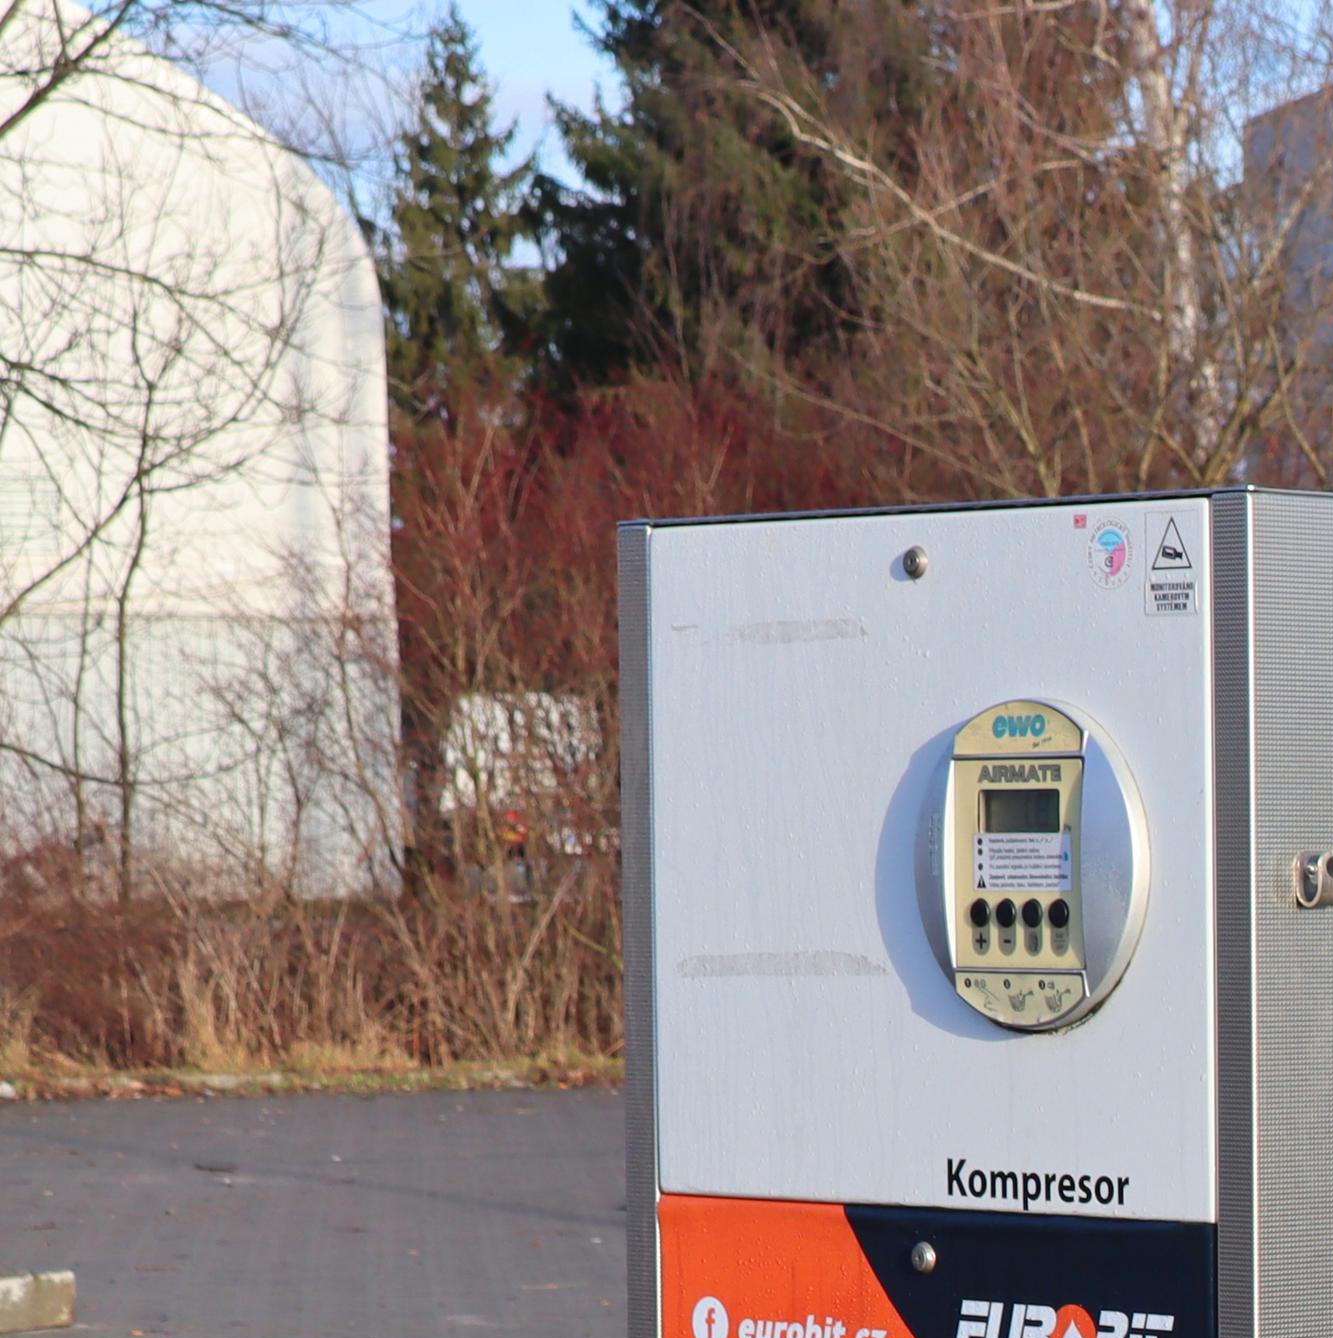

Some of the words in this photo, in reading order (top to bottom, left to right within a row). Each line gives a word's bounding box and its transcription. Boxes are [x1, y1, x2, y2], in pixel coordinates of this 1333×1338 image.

[992, 714, 1046, 738] ewo
[977, 764, 1062, 784] AIRMATE
[945, 1158, 1131, 1210] Kompresor
